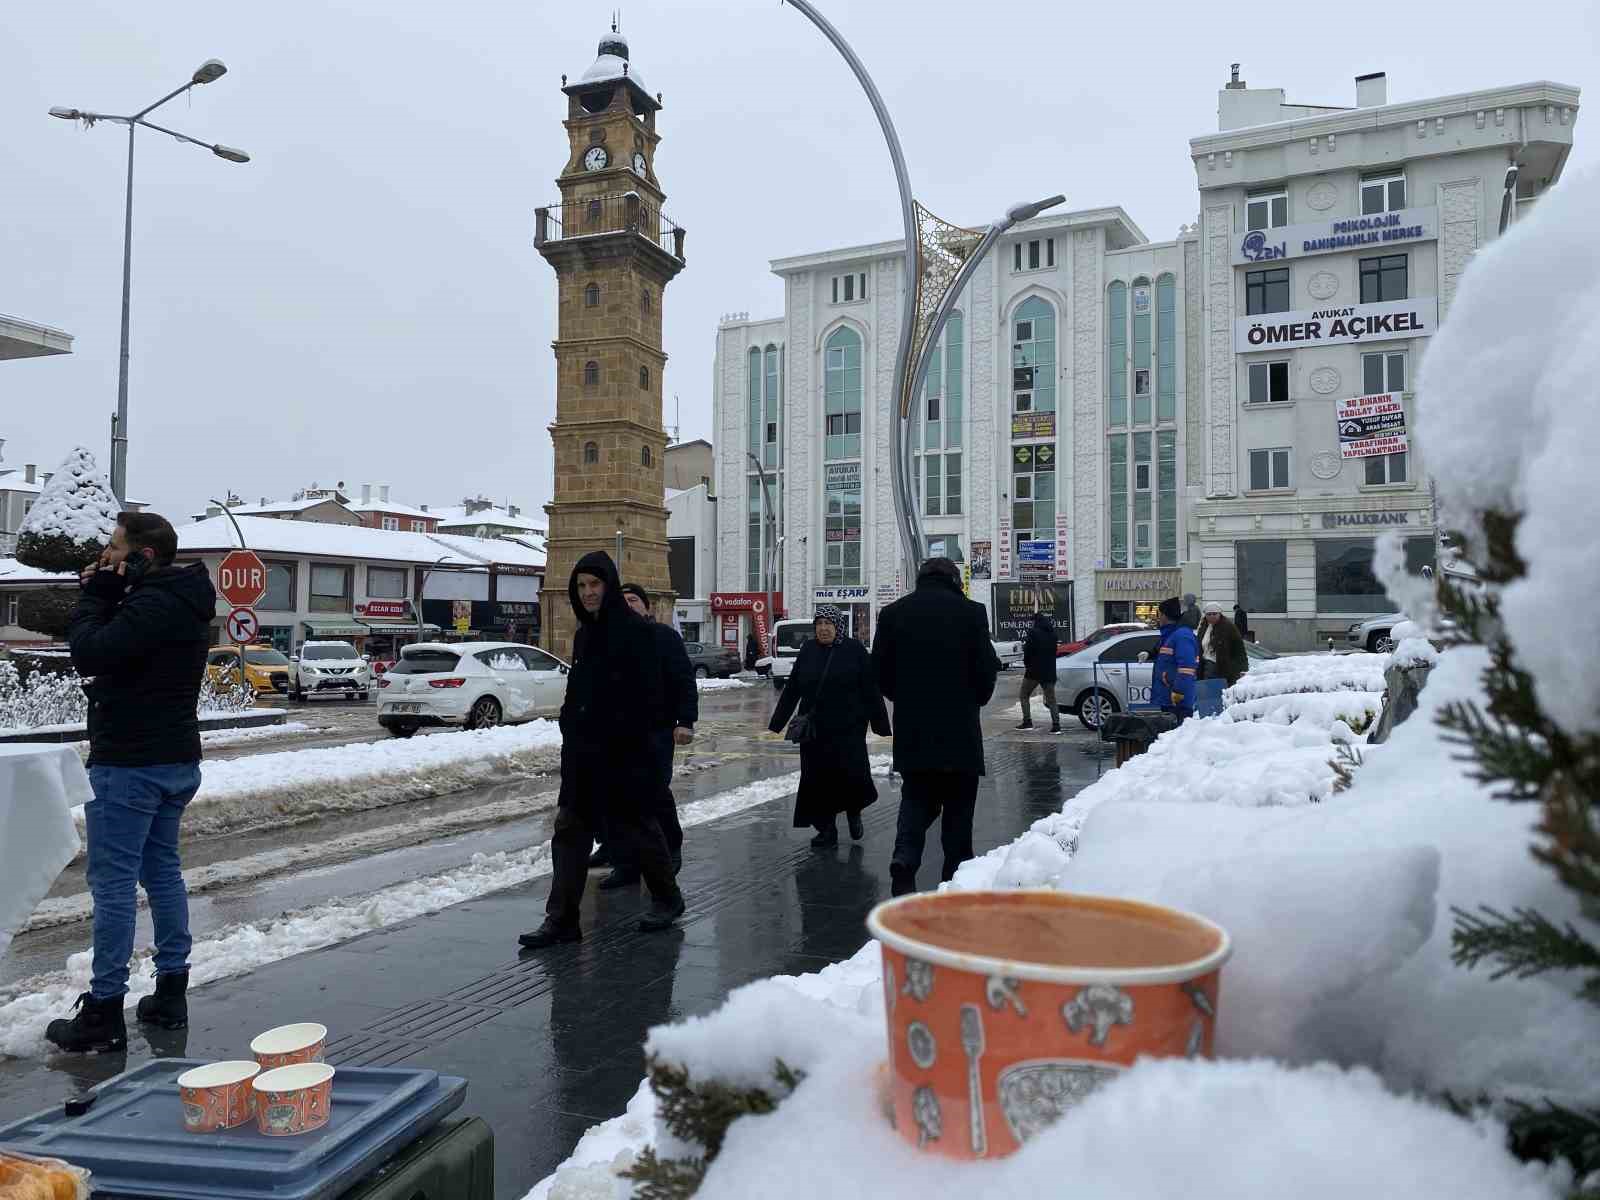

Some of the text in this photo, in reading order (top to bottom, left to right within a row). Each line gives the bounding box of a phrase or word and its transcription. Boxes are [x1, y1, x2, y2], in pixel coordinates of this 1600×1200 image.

[1311, 307, 1355, 320] AVUKAT
[1247, 311, 1425, 345] ÖMER AÇIKEL
[1336, 512, 1409, 526] HALKBANK
[222, 568, 262, 590] DUR
[724, 597, 753, 606] vodafon
